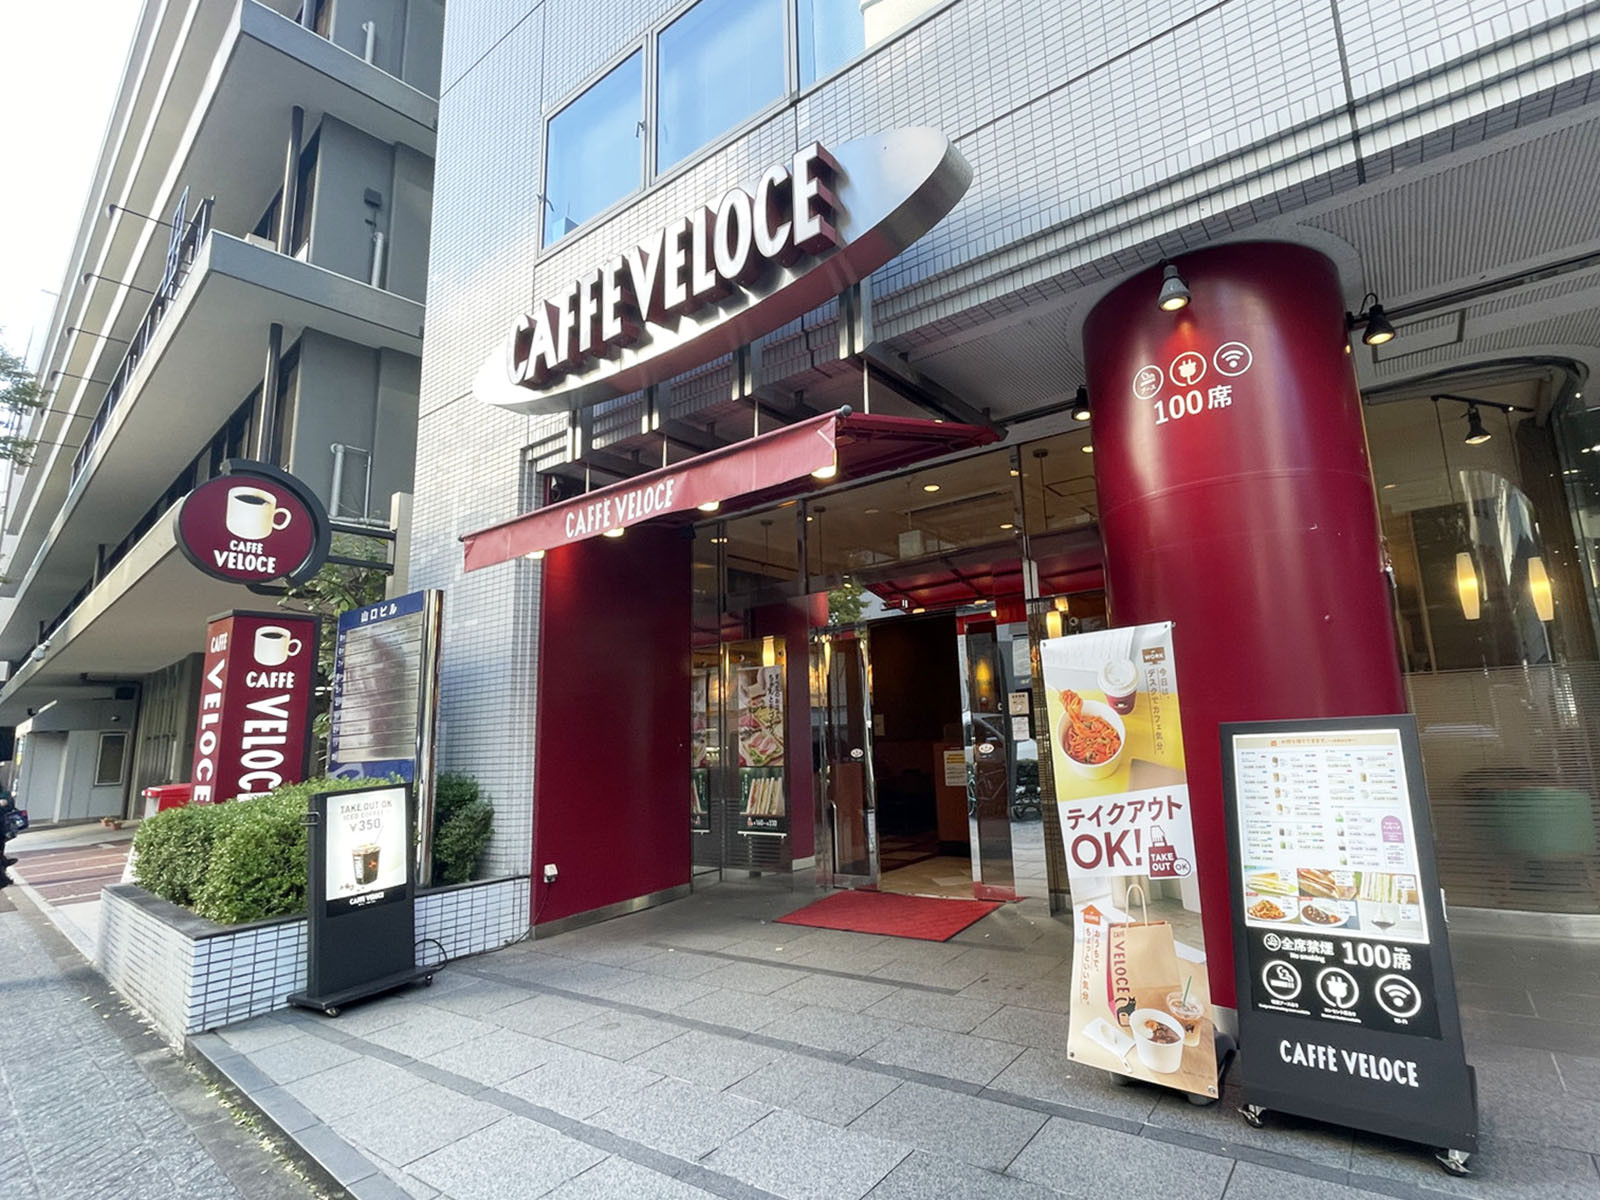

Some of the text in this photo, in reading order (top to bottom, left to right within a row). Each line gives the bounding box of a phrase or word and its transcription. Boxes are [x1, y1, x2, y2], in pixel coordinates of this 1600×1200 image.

[623, 140, 832, 322] VELOCE
[614, 479, 675, 522] VELOCE
[213, 549, 277, 574] VELOCE
[360, 602, 398, 624] 山口ビル
[193, 658, 226, 802] VELOCE
[340, 802, 362, 815] TAKE
[363, 800, 380, 811] OUT
[1067, 794, 1183, 831] テイクアウト
[1071, 828, 1143, 870] OK!
[1150, 851, 1175, 862] TAKE
[1151, 862, 1172, 872] OUT
[1174, 863, 1190, 872] OK
[1281, 936, 1336, 956] 全席禁煙
[1113, 940, 1131, 993] VELOCE
[1341, 1049, 1420, 1088] VELOCE
